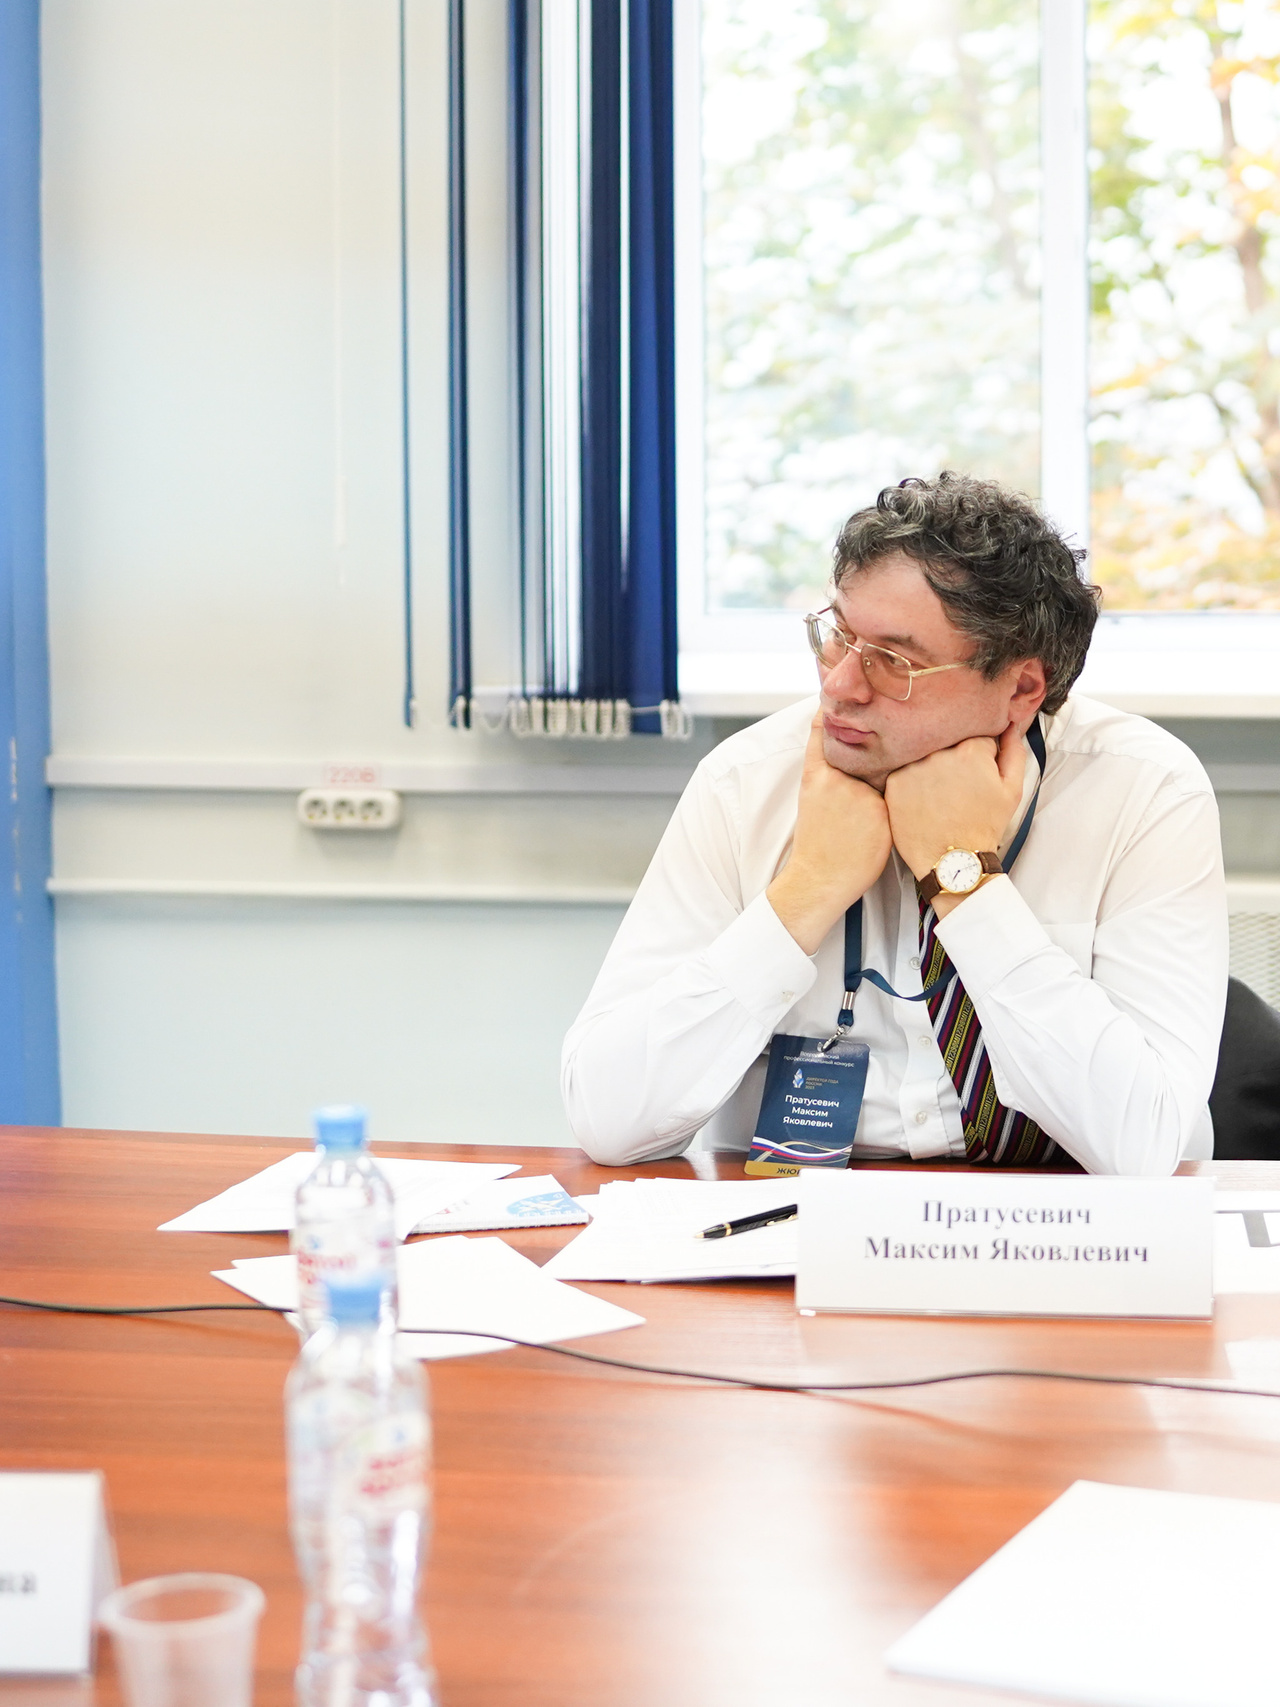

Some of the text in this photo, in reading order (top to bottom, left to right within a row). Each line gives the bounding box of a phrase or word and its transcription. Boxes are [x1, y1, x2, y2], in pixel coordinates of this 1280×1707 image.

[785, 1094, 840, 1108] Пратусевич
[791, 1106, 829, 1117] Максим
[783, 1116, 833, 1128] Яковлевич
[921, 1199, 1092, 1229] Пратусевич
[863, 1236, 1150, 1263] Максим Яковлевич
